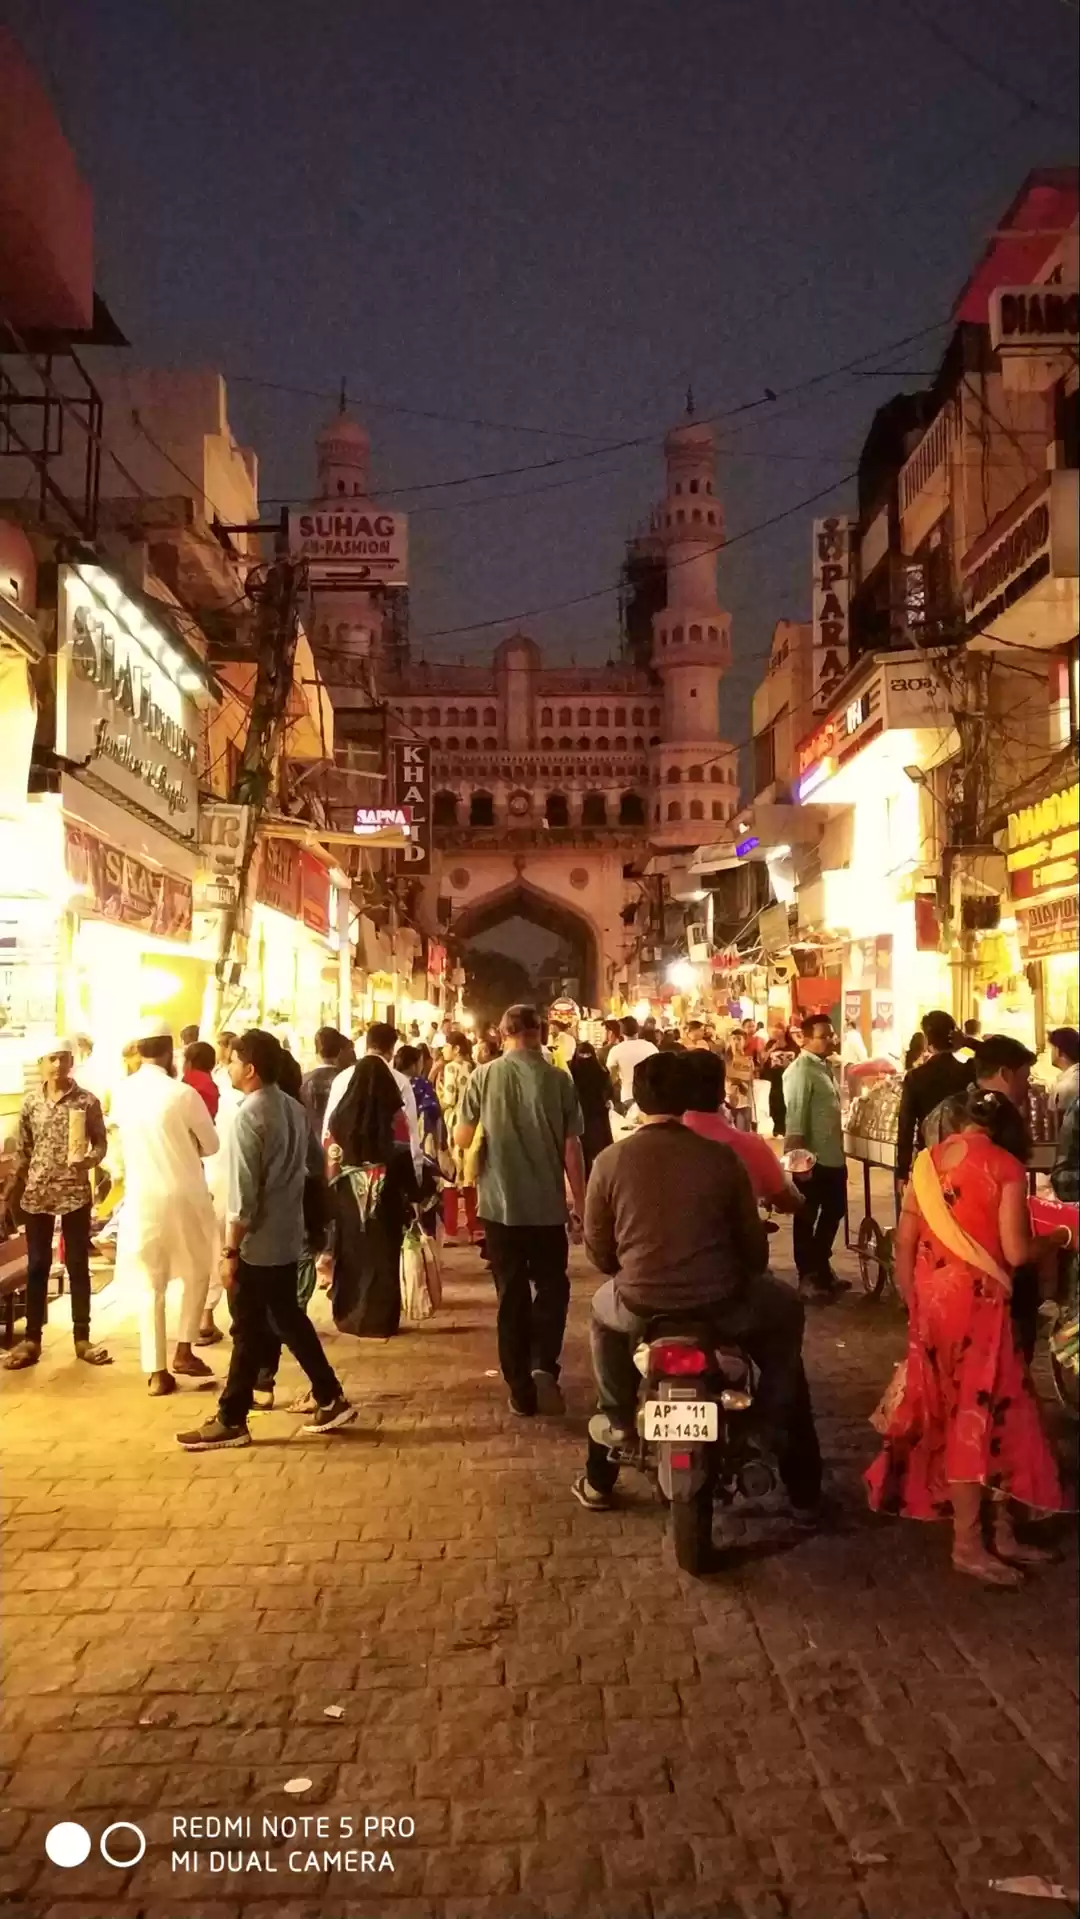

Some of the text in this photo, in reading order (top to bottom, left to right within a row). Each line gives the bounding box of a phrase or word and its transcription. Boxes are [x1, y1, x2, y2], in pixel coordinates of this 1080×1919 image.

[300, 515, 396, 537] SUHAG
[403, 746, 425, 862] KHALID
[356, 809, 407, 825] SAPNA
[1029, 897, 1078, 926] DIAMO
[653, 1405, 706, 1419] AP 11
[675, 1424, 709, 1438] 1434
